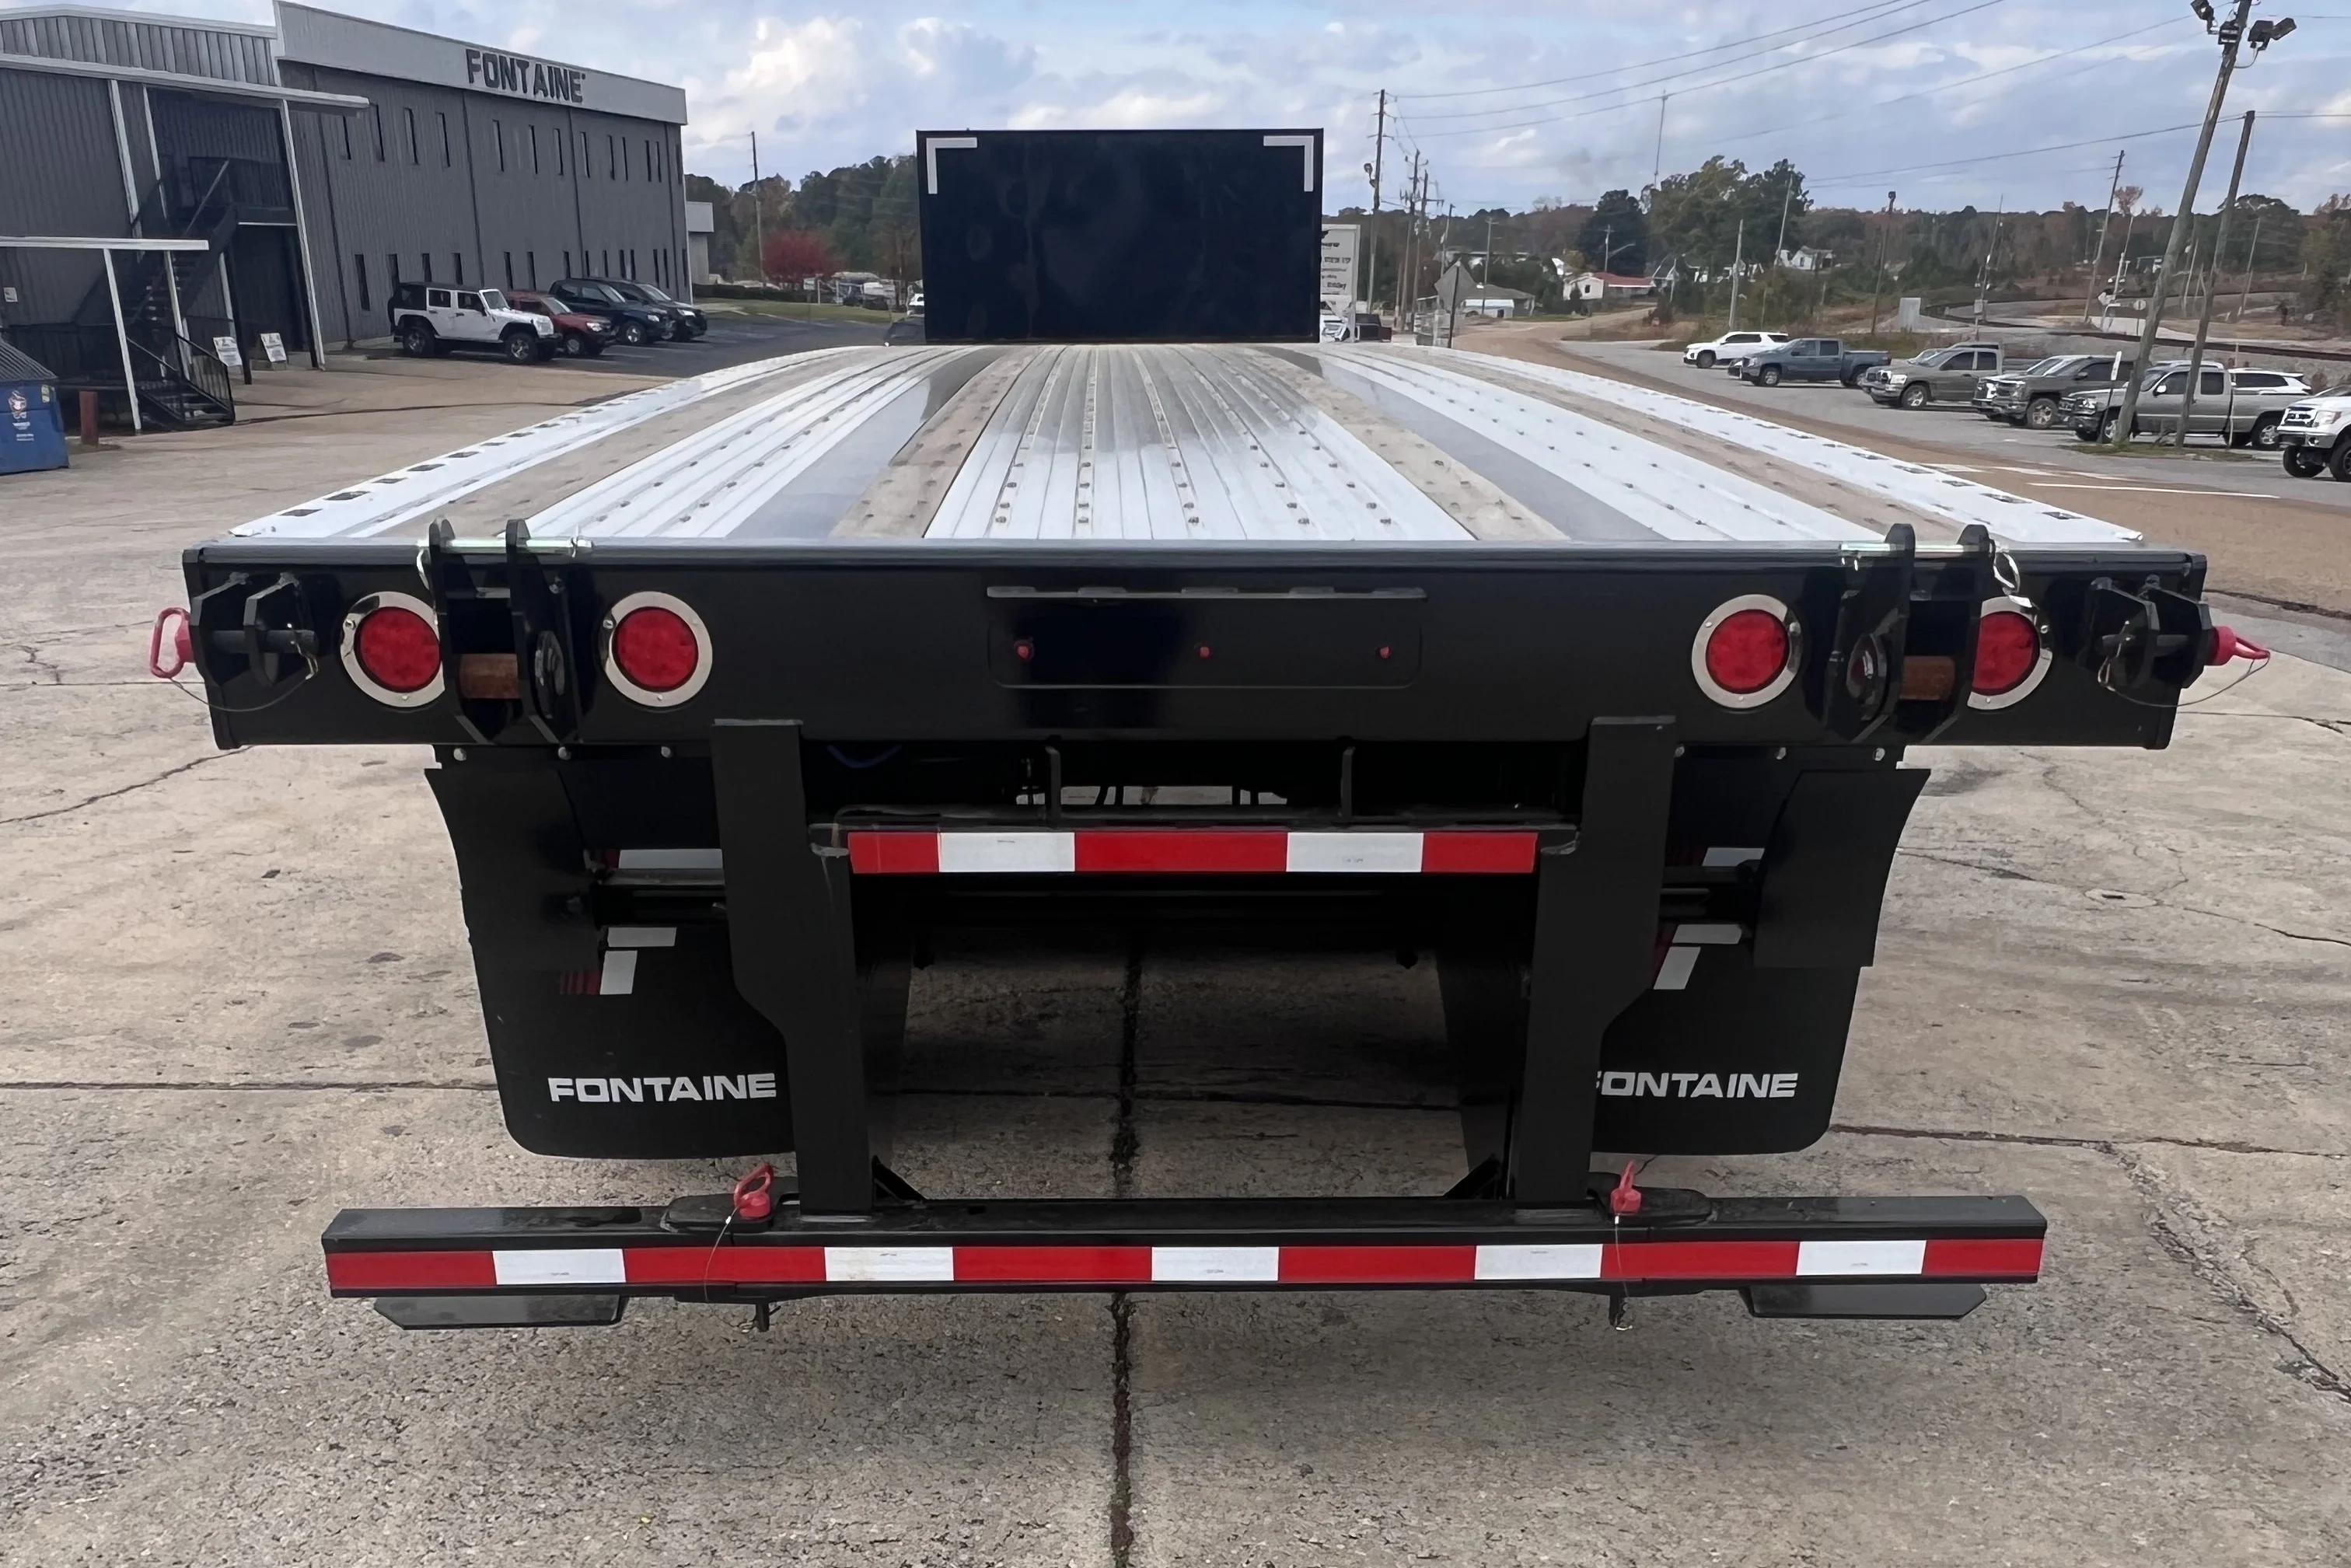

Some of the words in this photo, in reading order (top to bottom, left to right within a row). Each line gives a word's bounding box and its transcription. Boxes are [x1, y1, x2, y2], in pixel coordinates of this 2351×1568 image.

[466, 48, 583, 103] FONTAINE
[547, 1073, 777, 1102] FONTAINE
[1596, 1070, 1798, 1098] ONTAINE
